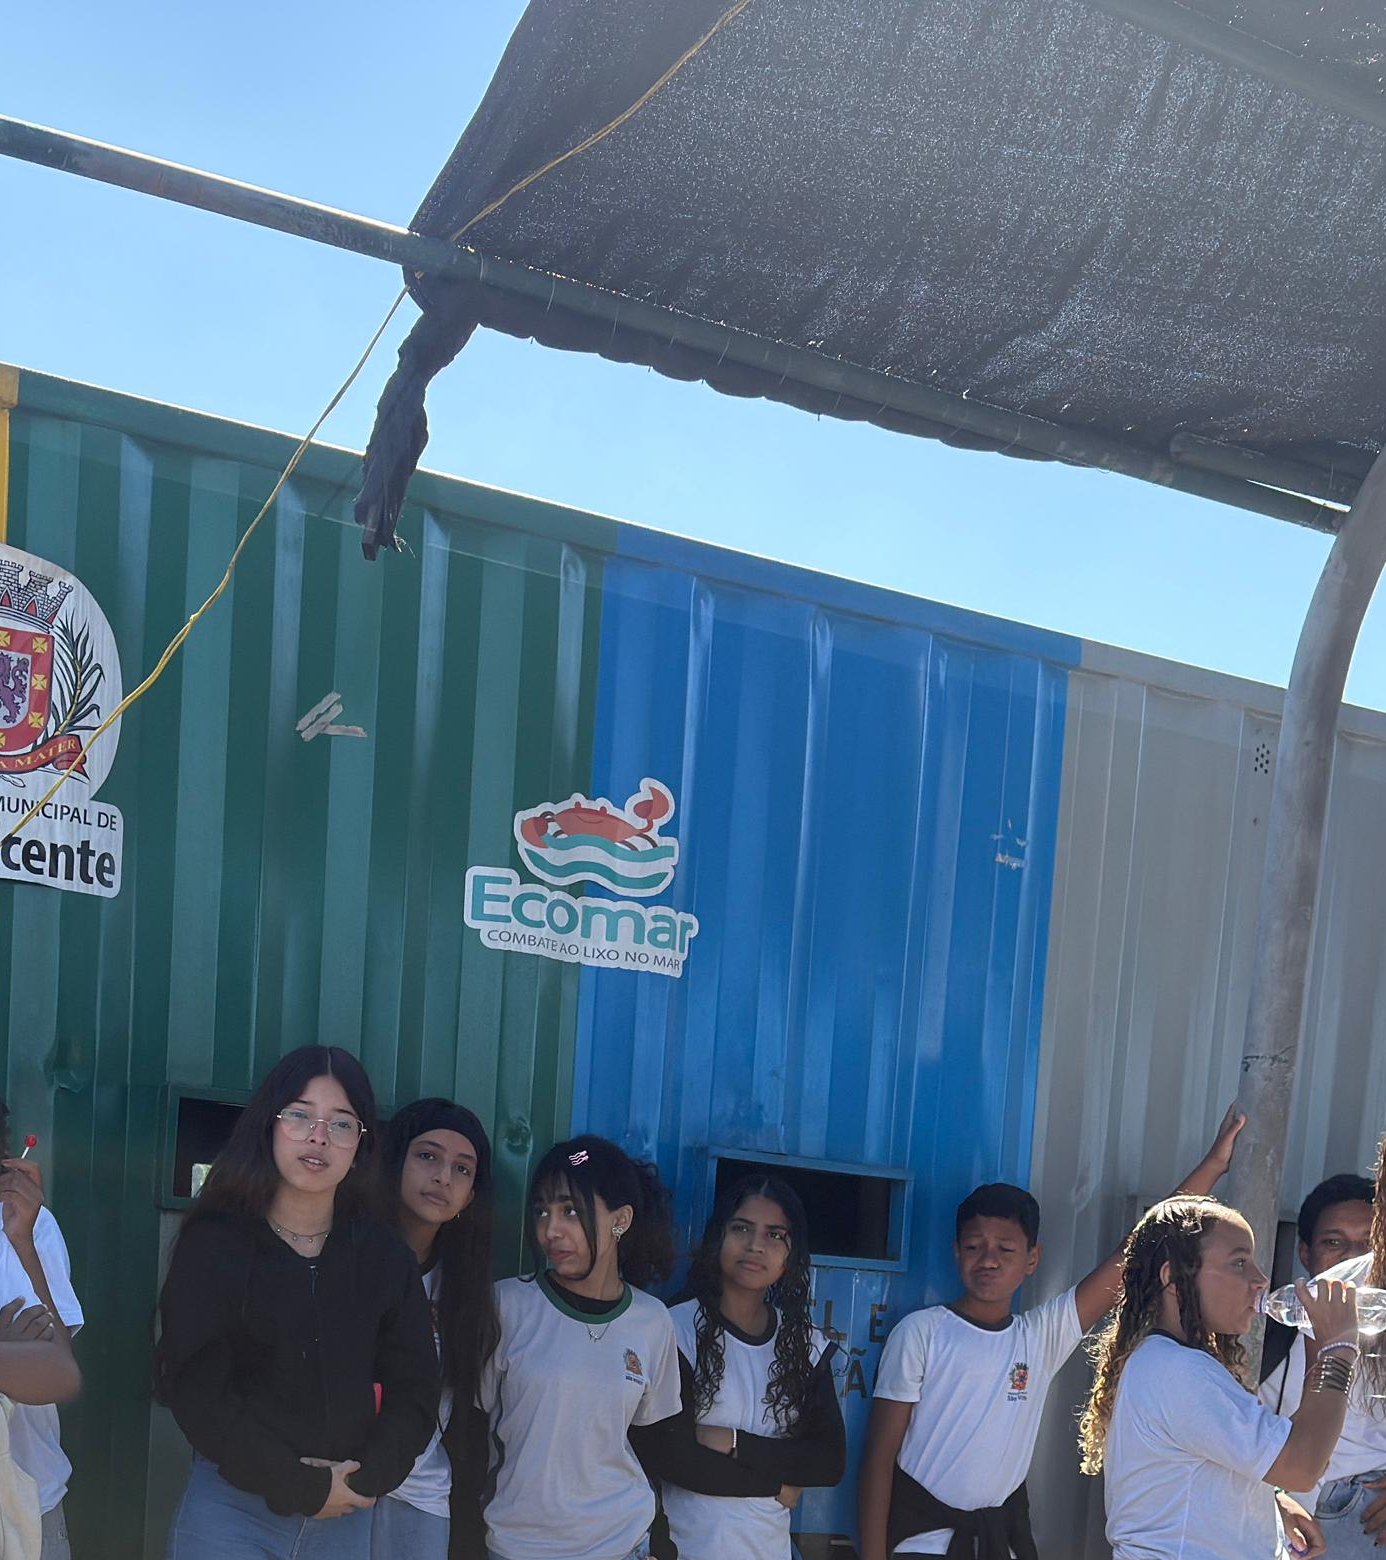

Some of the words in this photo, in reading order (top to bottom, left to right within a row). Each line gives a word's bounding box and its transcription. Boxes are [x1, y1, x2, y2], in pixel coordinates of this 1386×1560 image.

[15, 738, 76, 768] MATER
[97, 811, 118, 832] DE
[470, 874, 694, 955] Ecomar
[487, 929, 558, 952] COMBATE
[560, 941, 580, 956] AO
[583, 947, 620, 962] LIXO
[625, 951, 649, 965] NO
[653, 955, 681, 971] MAR
